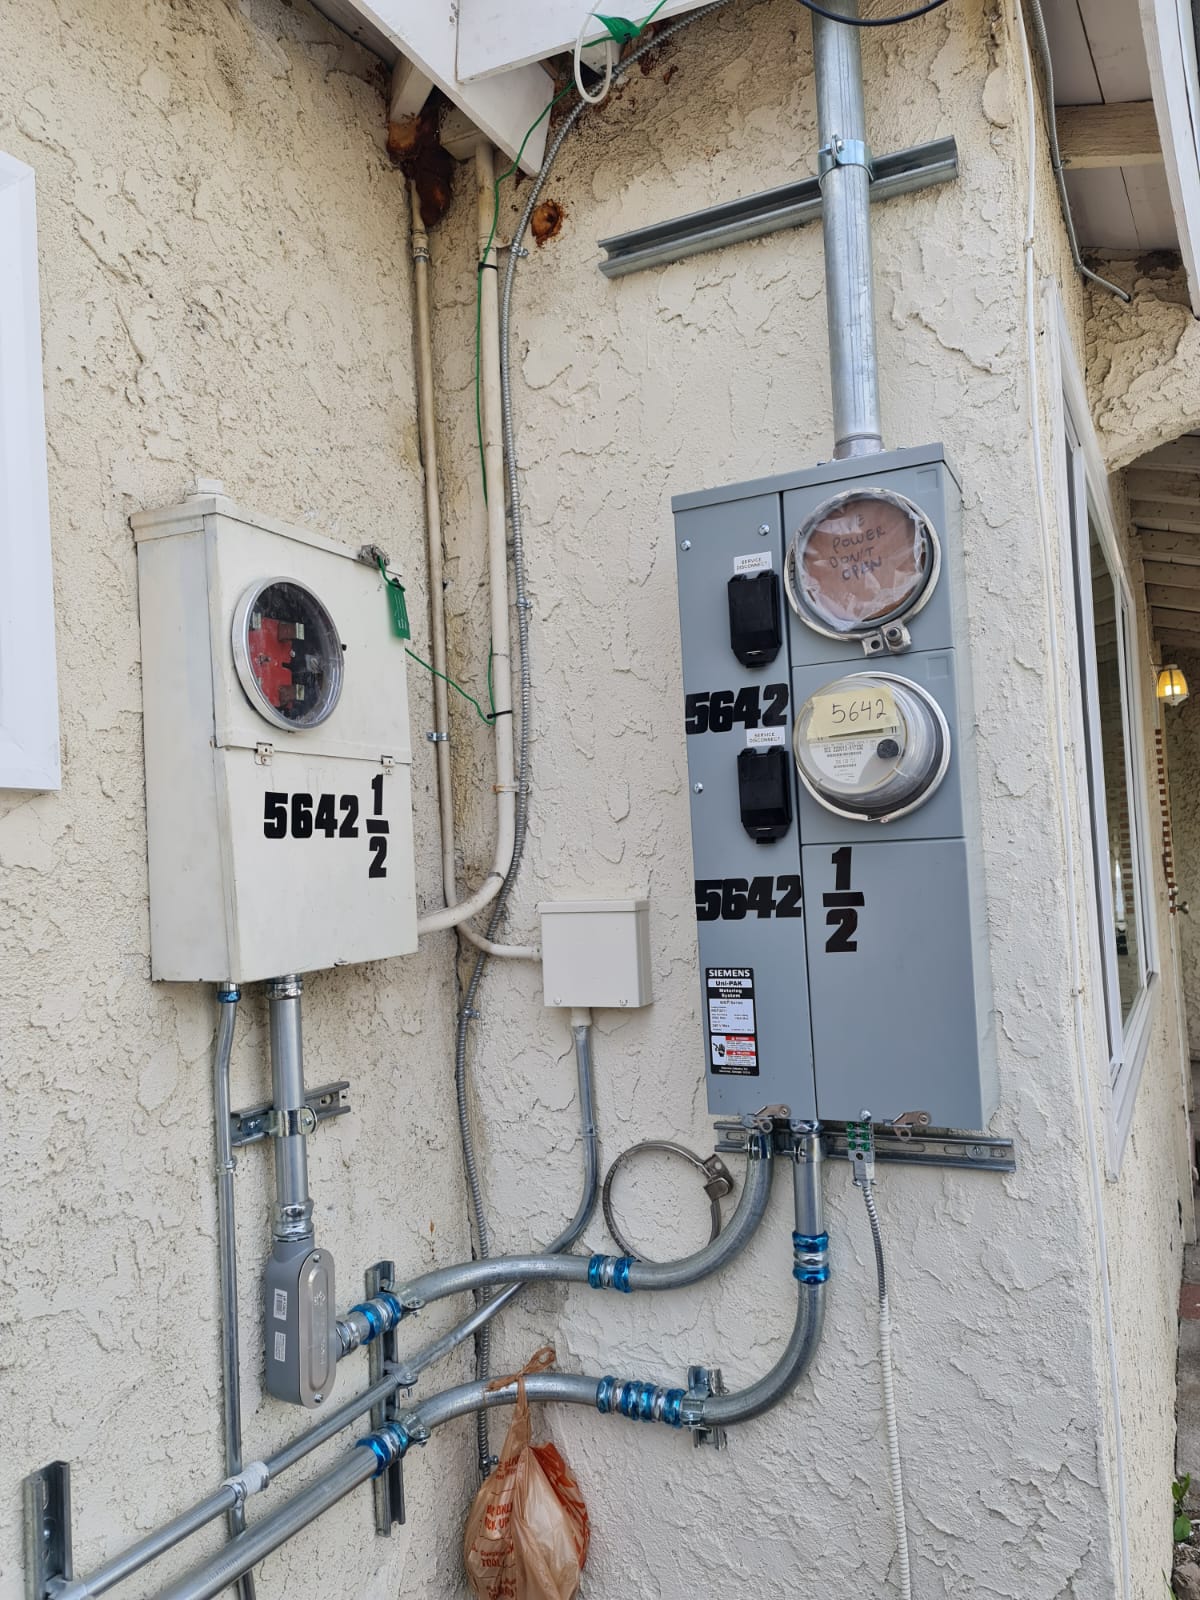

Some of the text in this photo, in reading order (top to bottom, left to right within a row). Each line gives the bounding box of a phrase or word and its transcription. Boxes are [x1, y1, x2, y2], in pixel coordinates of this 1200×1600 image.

[832, 526, 886, 554] POWER
[685, 683, 789, 735] 5642
[832, 698, 887, 724] 5642
[264, 791, 359, 839] 5642
[695, 875, 801, 921] 5642
[709, 969, 751, 977] SIEMENS
